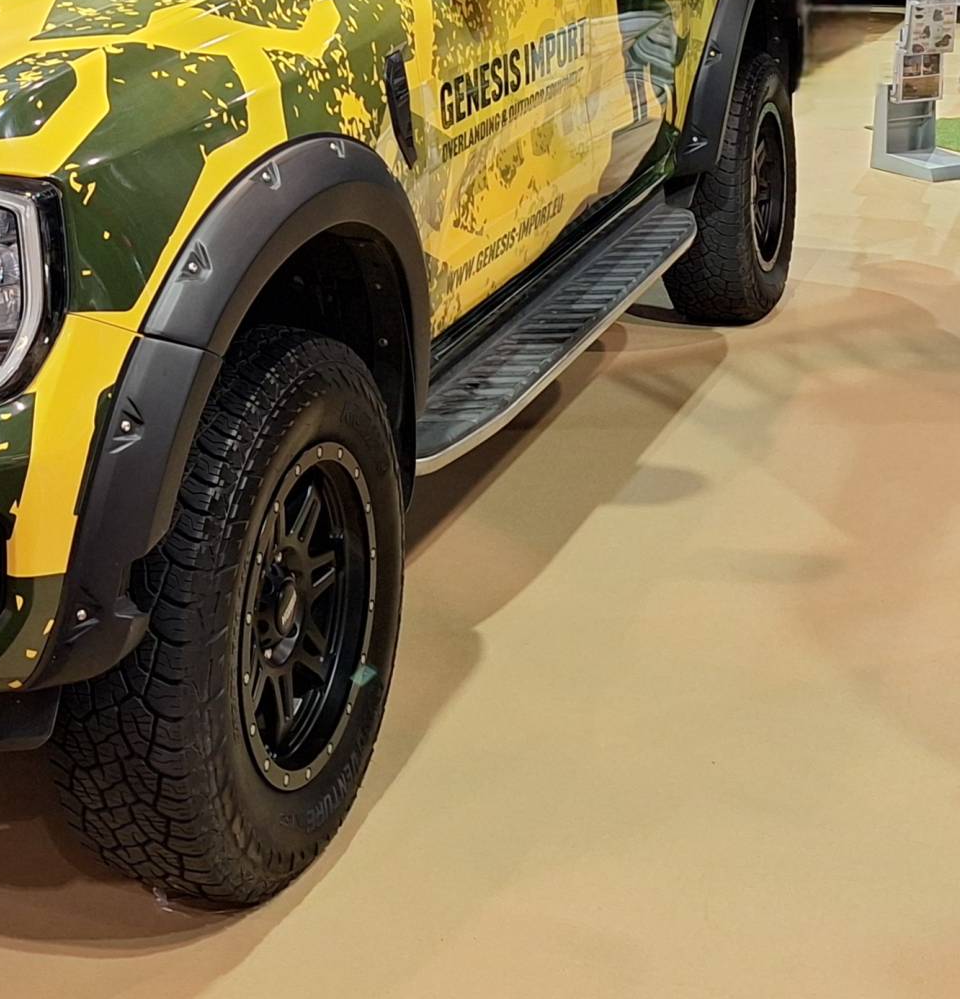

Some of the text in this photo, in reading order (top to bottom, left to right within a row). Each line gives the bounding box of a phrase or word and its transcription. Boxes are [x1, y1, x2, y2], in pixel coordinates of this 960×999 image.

[440, 18, 587, 130] GENESIS IMPORT
[441, 112, 500, 164] OVERLANDING
